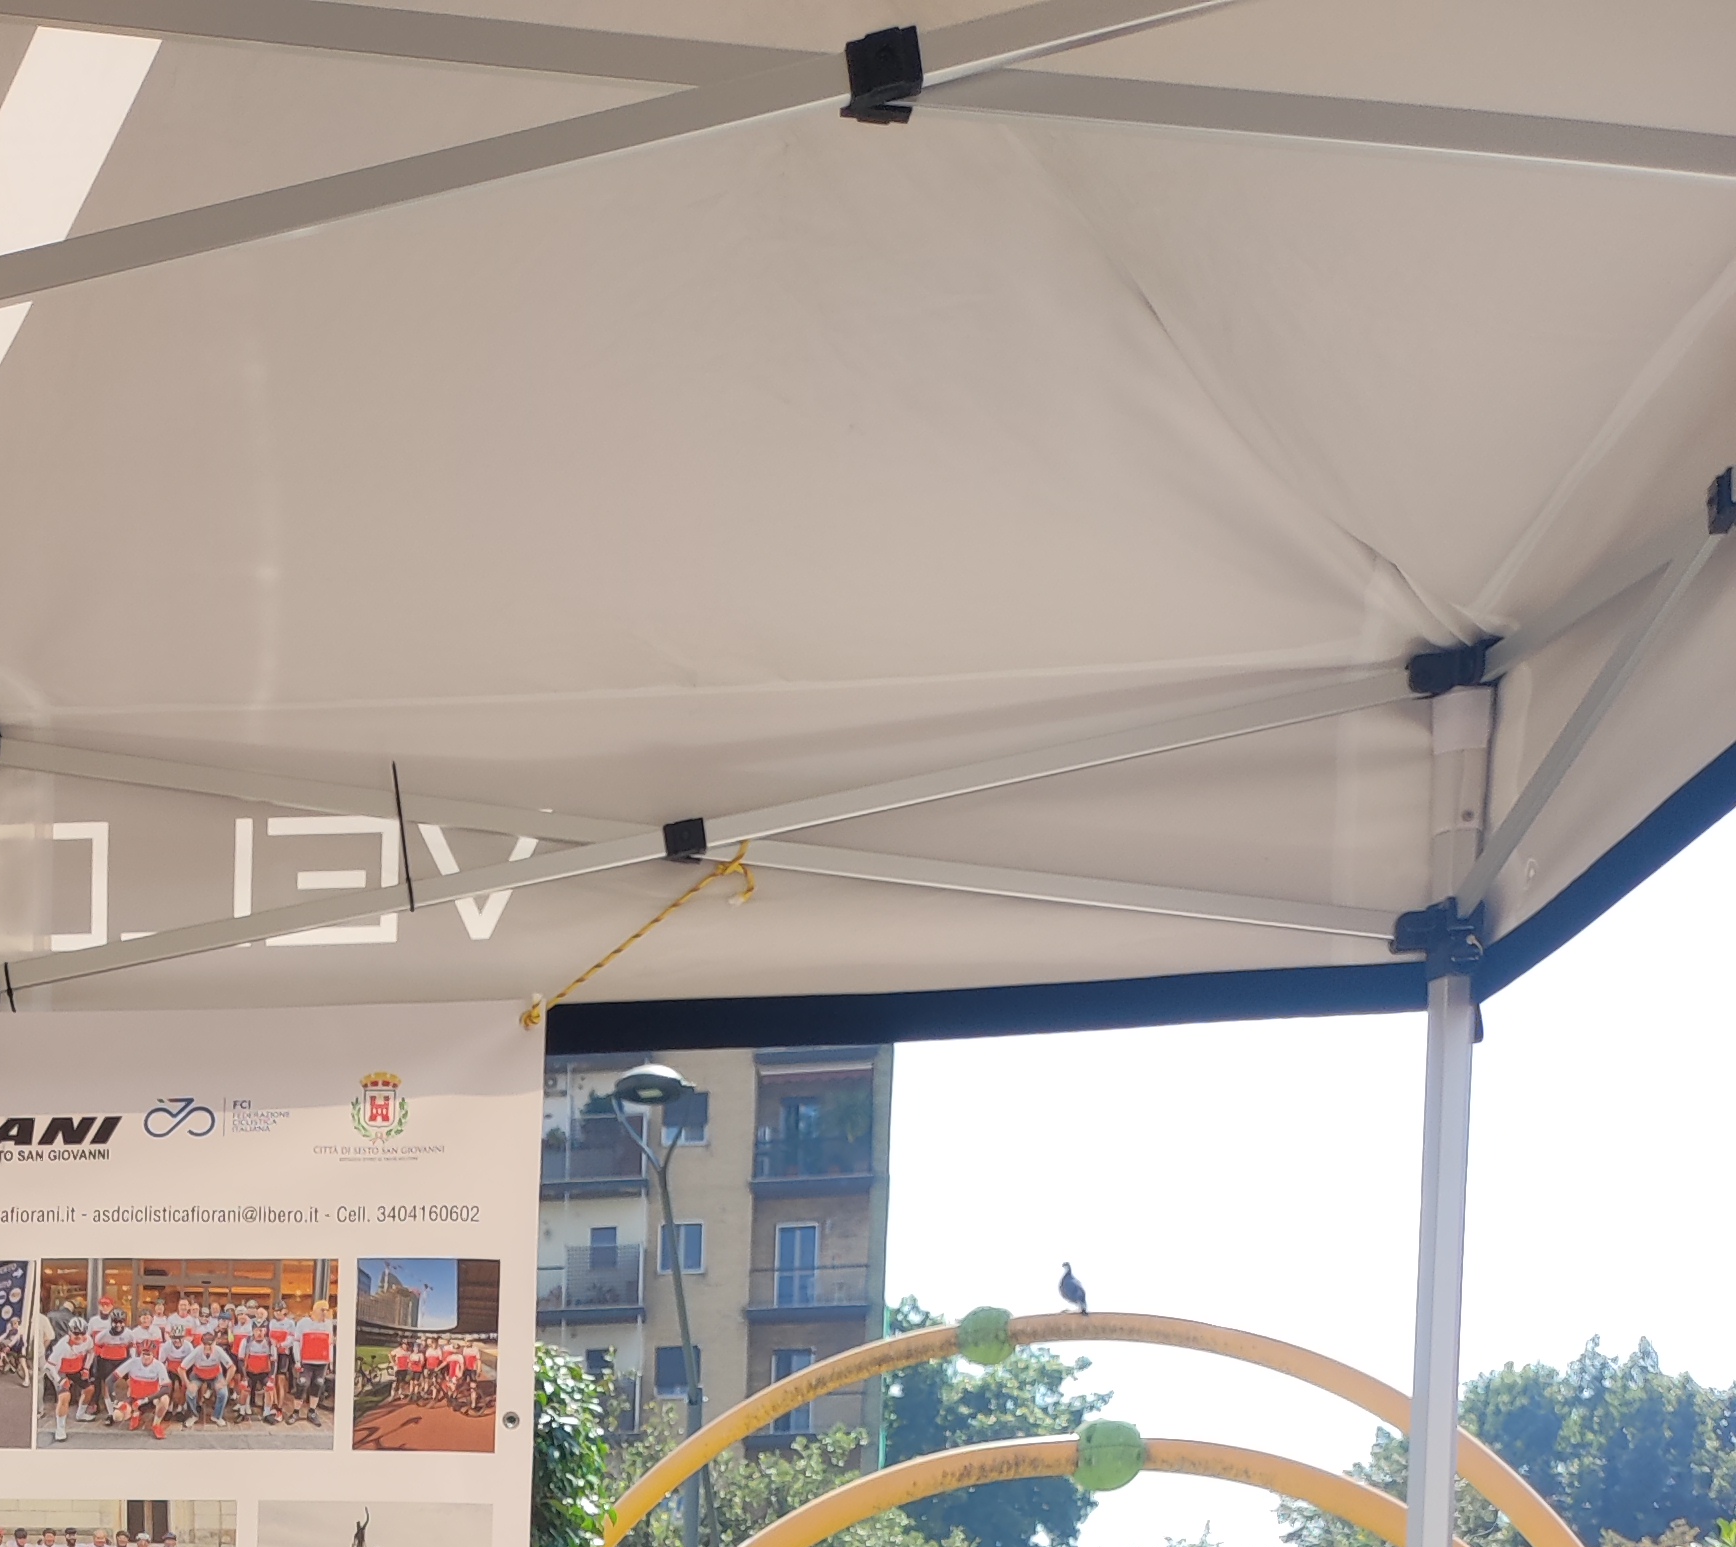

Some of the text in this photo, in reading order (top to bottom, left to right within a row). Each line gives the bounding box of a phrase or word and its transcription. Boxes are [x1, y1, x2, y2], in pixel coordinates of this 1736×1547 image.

[232, 1100, 252, 1110] FCI
[17, 1149, 43, 1162] SAN
[47, 1148, 110, 1162] GIOVANNI
[92, 1205, 319, 1225] asdciclisticafiorani@libero.it
[336, 1205, 371, 1223] Cell.
[376, 1205, 481, 1224] 3404160602
